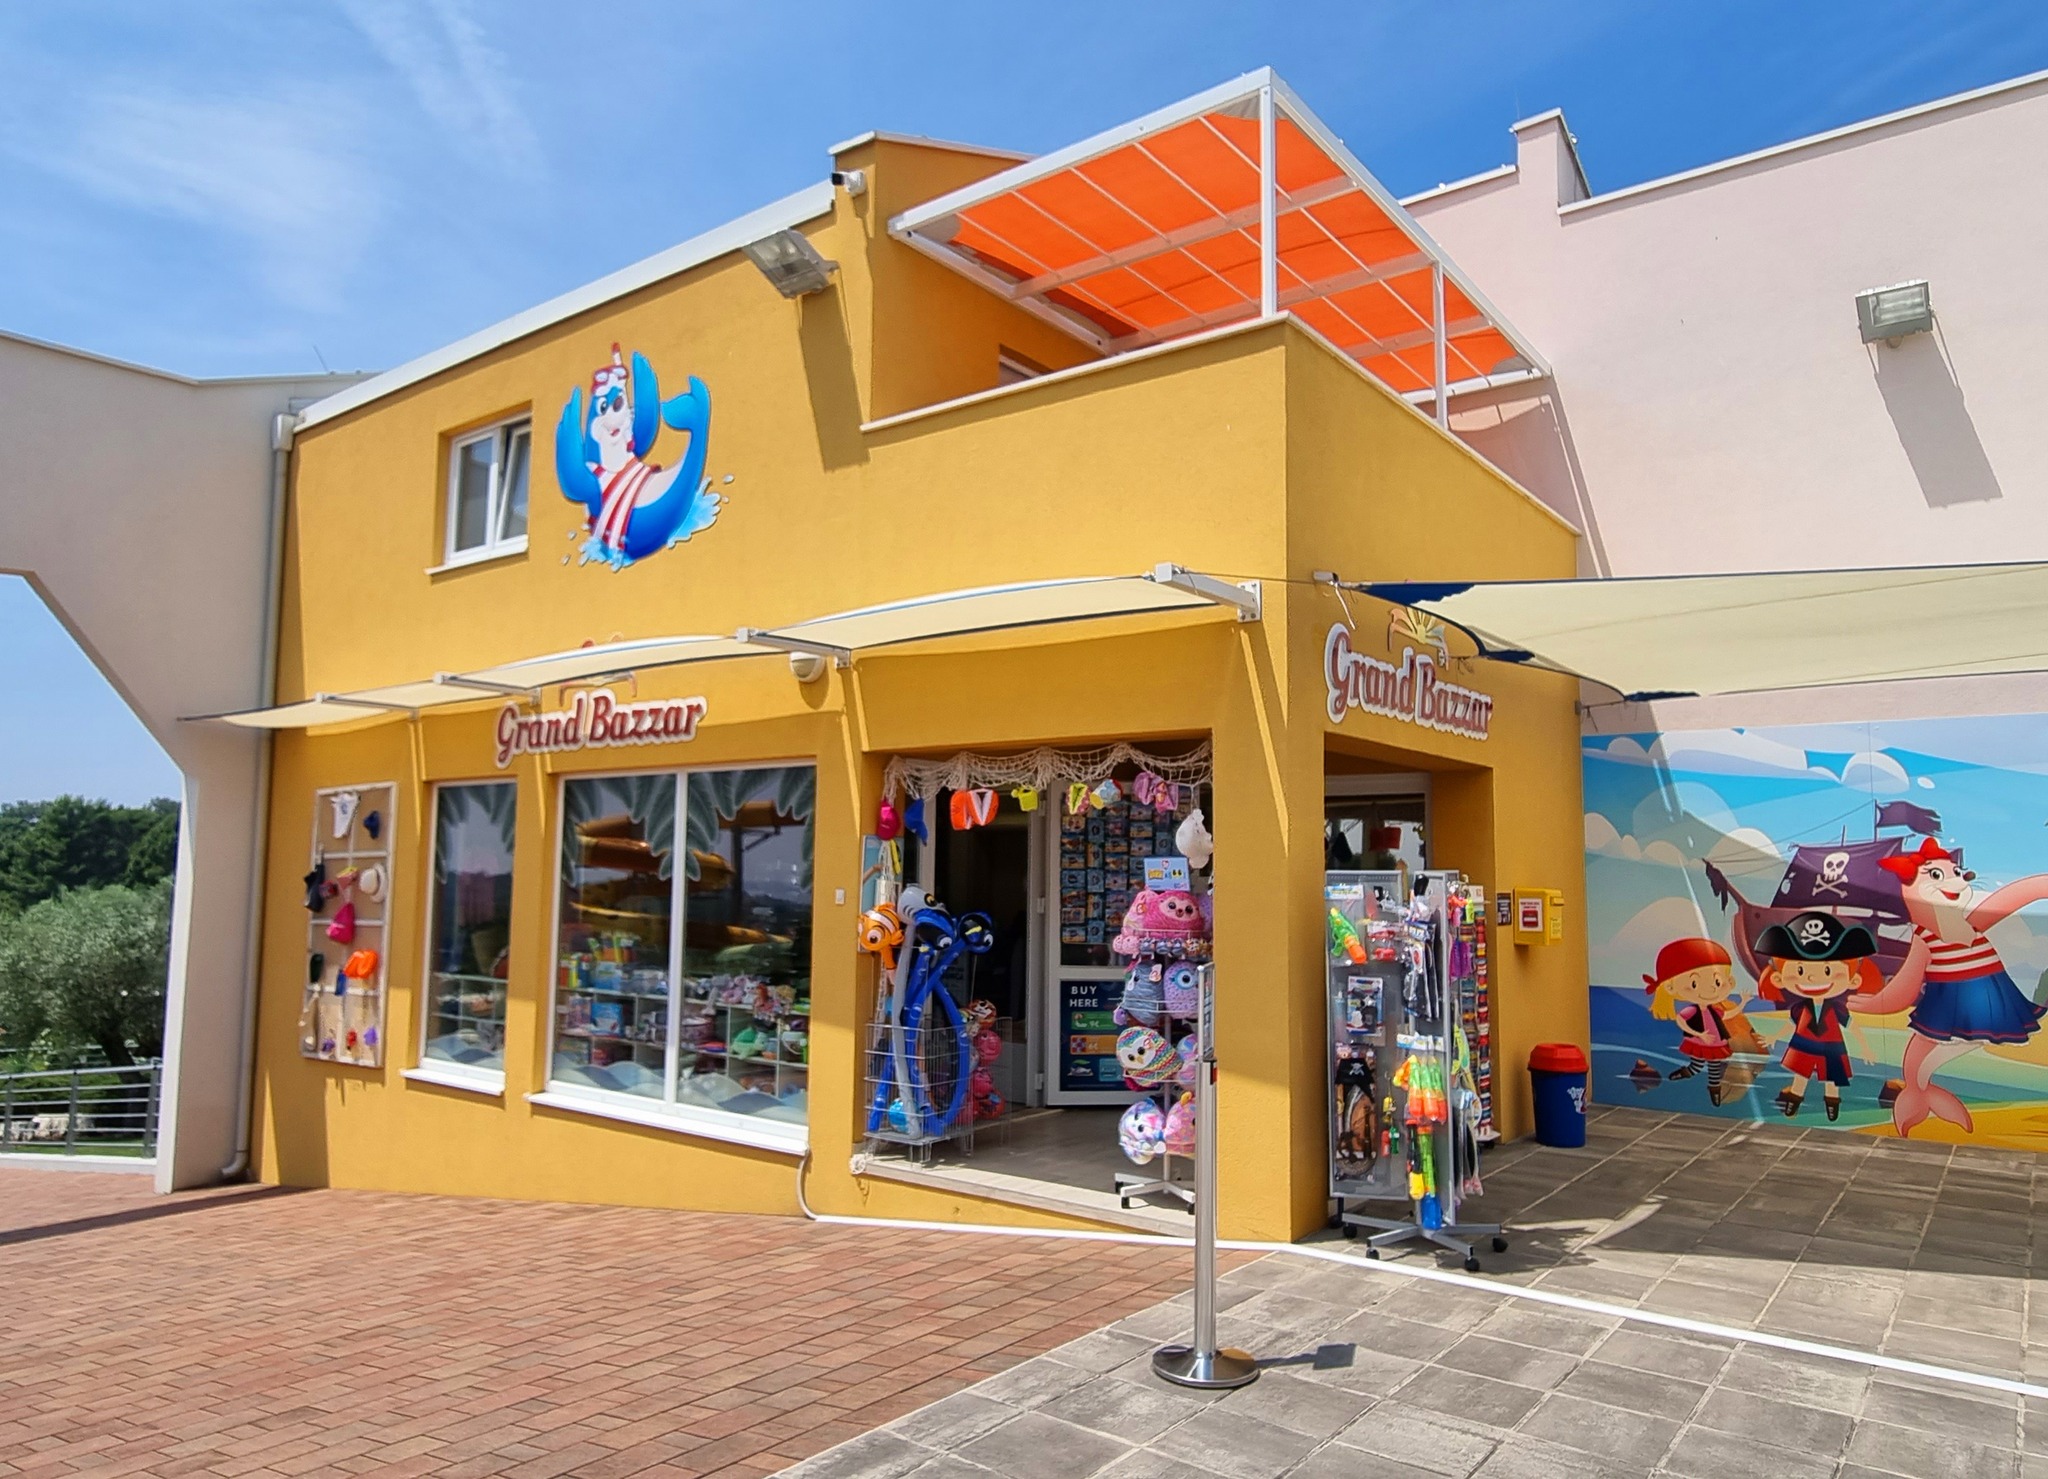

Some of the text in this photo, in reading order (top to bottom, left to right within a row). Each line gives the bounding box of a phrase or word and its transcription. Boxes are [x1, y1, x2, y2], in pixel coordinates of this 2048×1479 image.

[1330, 631, 1493, 733] Grand Bazzar
[497, 694, 703, 765] Grand Bazzar
[1069, 998, 1099, 1008] HERE
[1071, 986, 1097, 995] BUY
